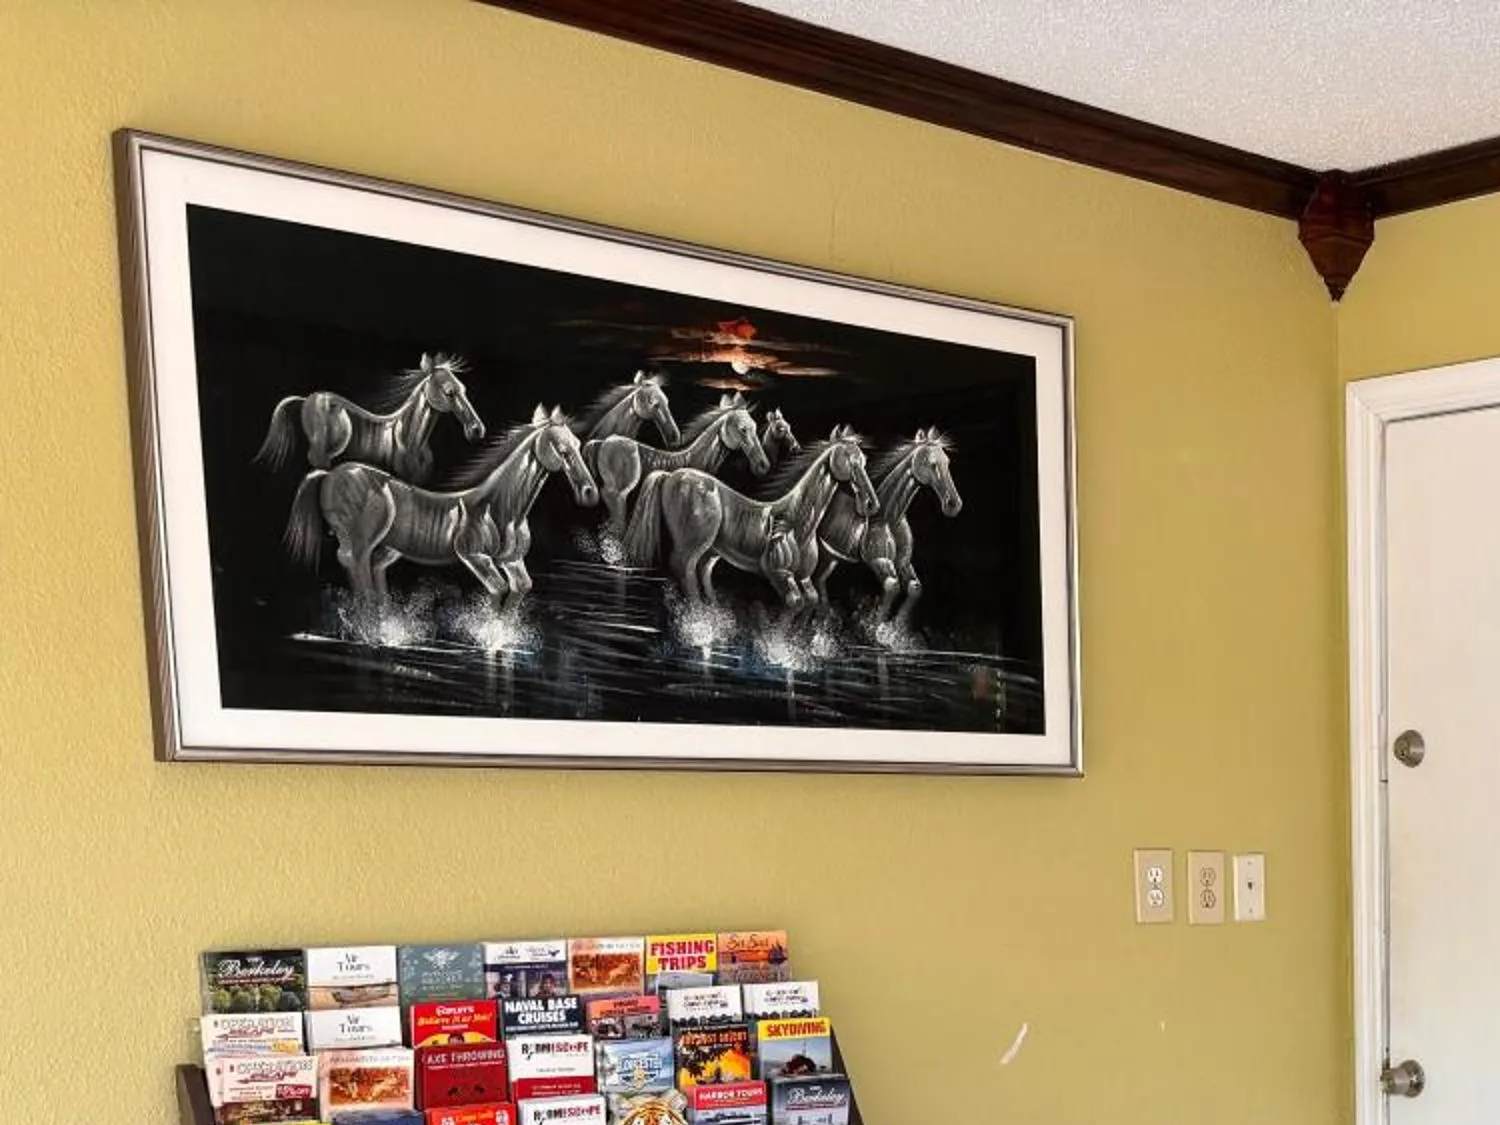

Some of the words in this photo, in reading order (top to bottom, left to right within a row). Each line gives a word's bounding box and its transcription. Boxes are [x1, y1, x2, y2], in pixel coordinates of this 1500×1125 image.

[650, 939, 715, 956] FISHING
[657, 954, 707, 971] TRIPS
[504, 1001, 544, 1013] NAVAL
[547, 997, 577, 1010] BASE
[517, 1011, 567, 1025] CRUISES
[766, 1020, 827, 1037] SKYDIVING
